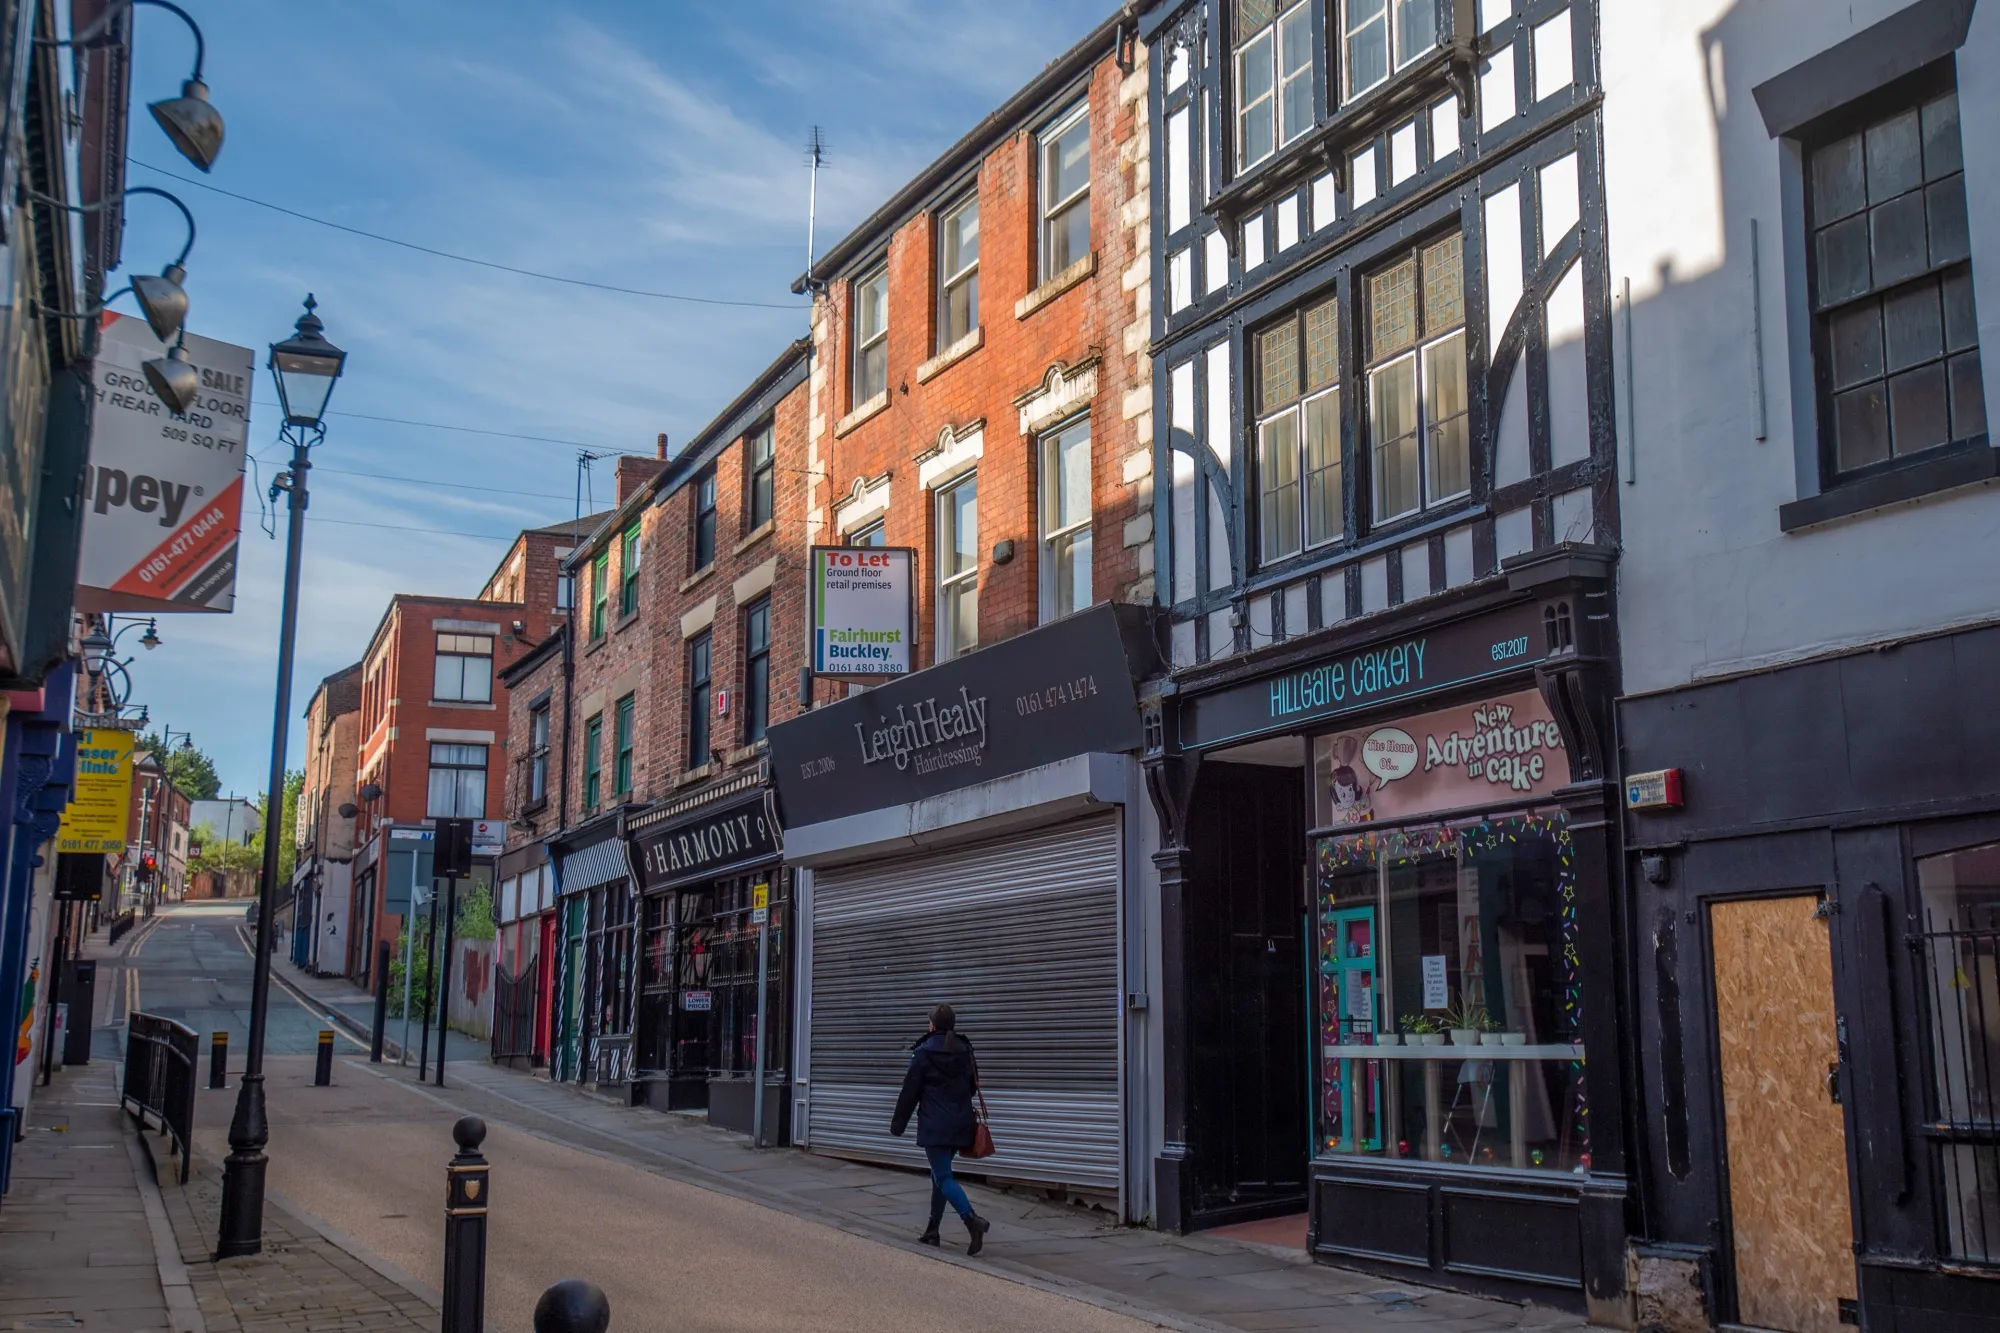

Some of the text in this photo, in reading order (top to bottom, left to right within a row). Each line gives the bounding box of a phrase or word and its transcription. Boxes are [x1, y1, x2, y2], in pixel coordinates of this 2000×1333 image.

[202, 368, 244, 396] SALE
[110, 393, 160, 416] REAR
[162, 426, 238, 454] 509 SQ FT
[192, 508, 224, 538] 0444
[827, 552, 890, 566] To Let
[826, 568, 882, 577] Ground floor
[826, 580, 892, 591] retail premises
[830, 628, 902, 643] Fairhurst
[830, 664, 902, 672] 0161 480 3880
[1016, 675, 1098, 716] 0161 474 1474
[78, 748, 118, 760] aser
[1367, 739, 1414, 753] The Home
[80, 761, 118, 774] linic
[800, 755, 836, 780] EST. 2006
[914, 742, 982, 776] Hairdressing
[1468, 753, 1544, 790] in cake
[653, 814, 752, 874] HARMONY
